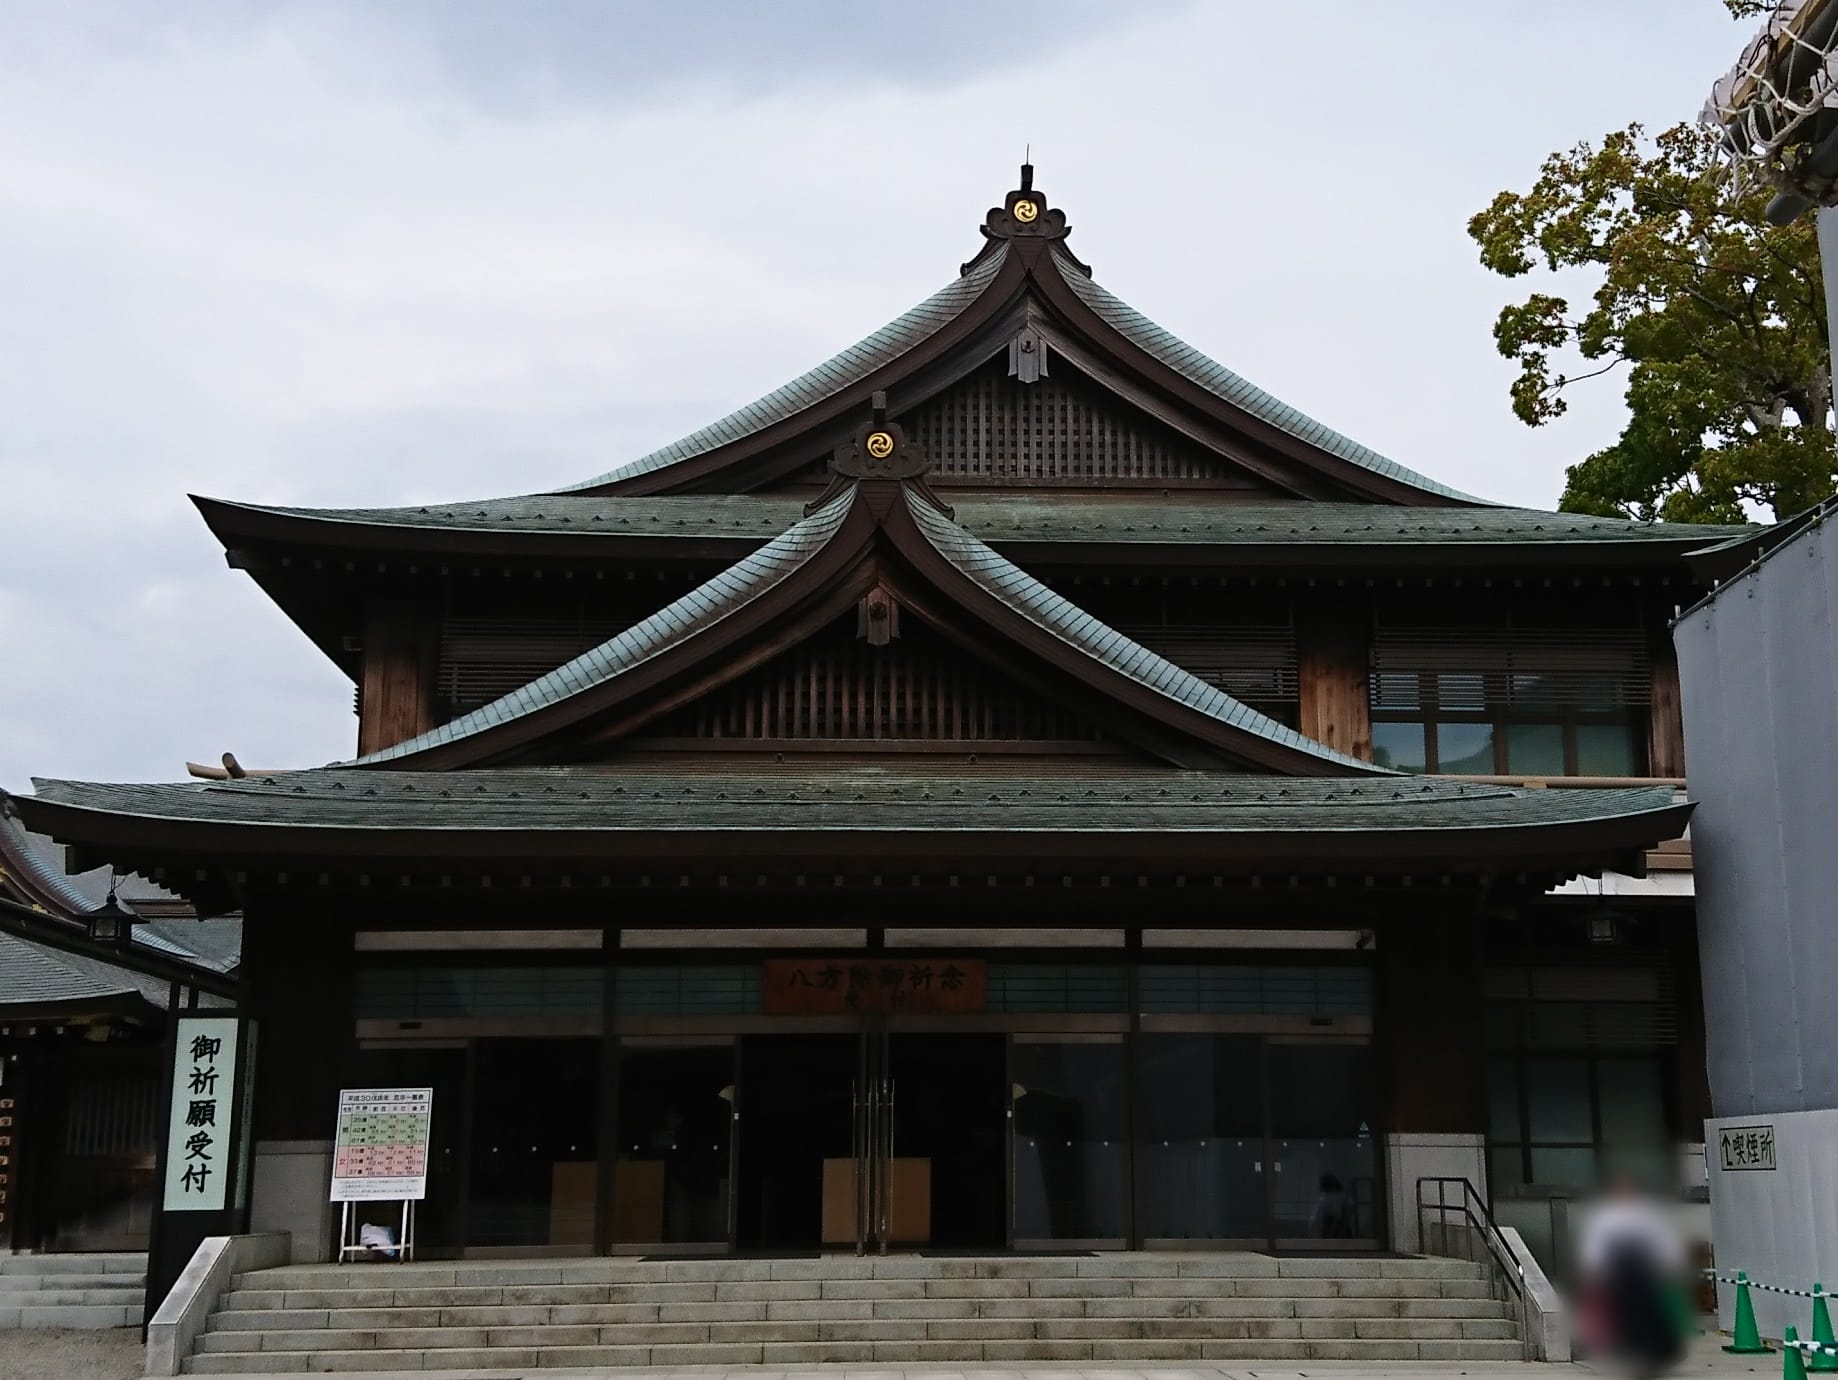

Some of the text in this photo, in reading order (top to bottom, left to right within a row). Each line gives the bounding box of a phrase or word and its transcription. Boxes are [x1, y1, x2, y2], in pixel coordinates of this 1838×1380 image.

[180, 1034, 222, 1193] 御祈願受付
[1733, 1130, 1773, 1165] 喫煙所
